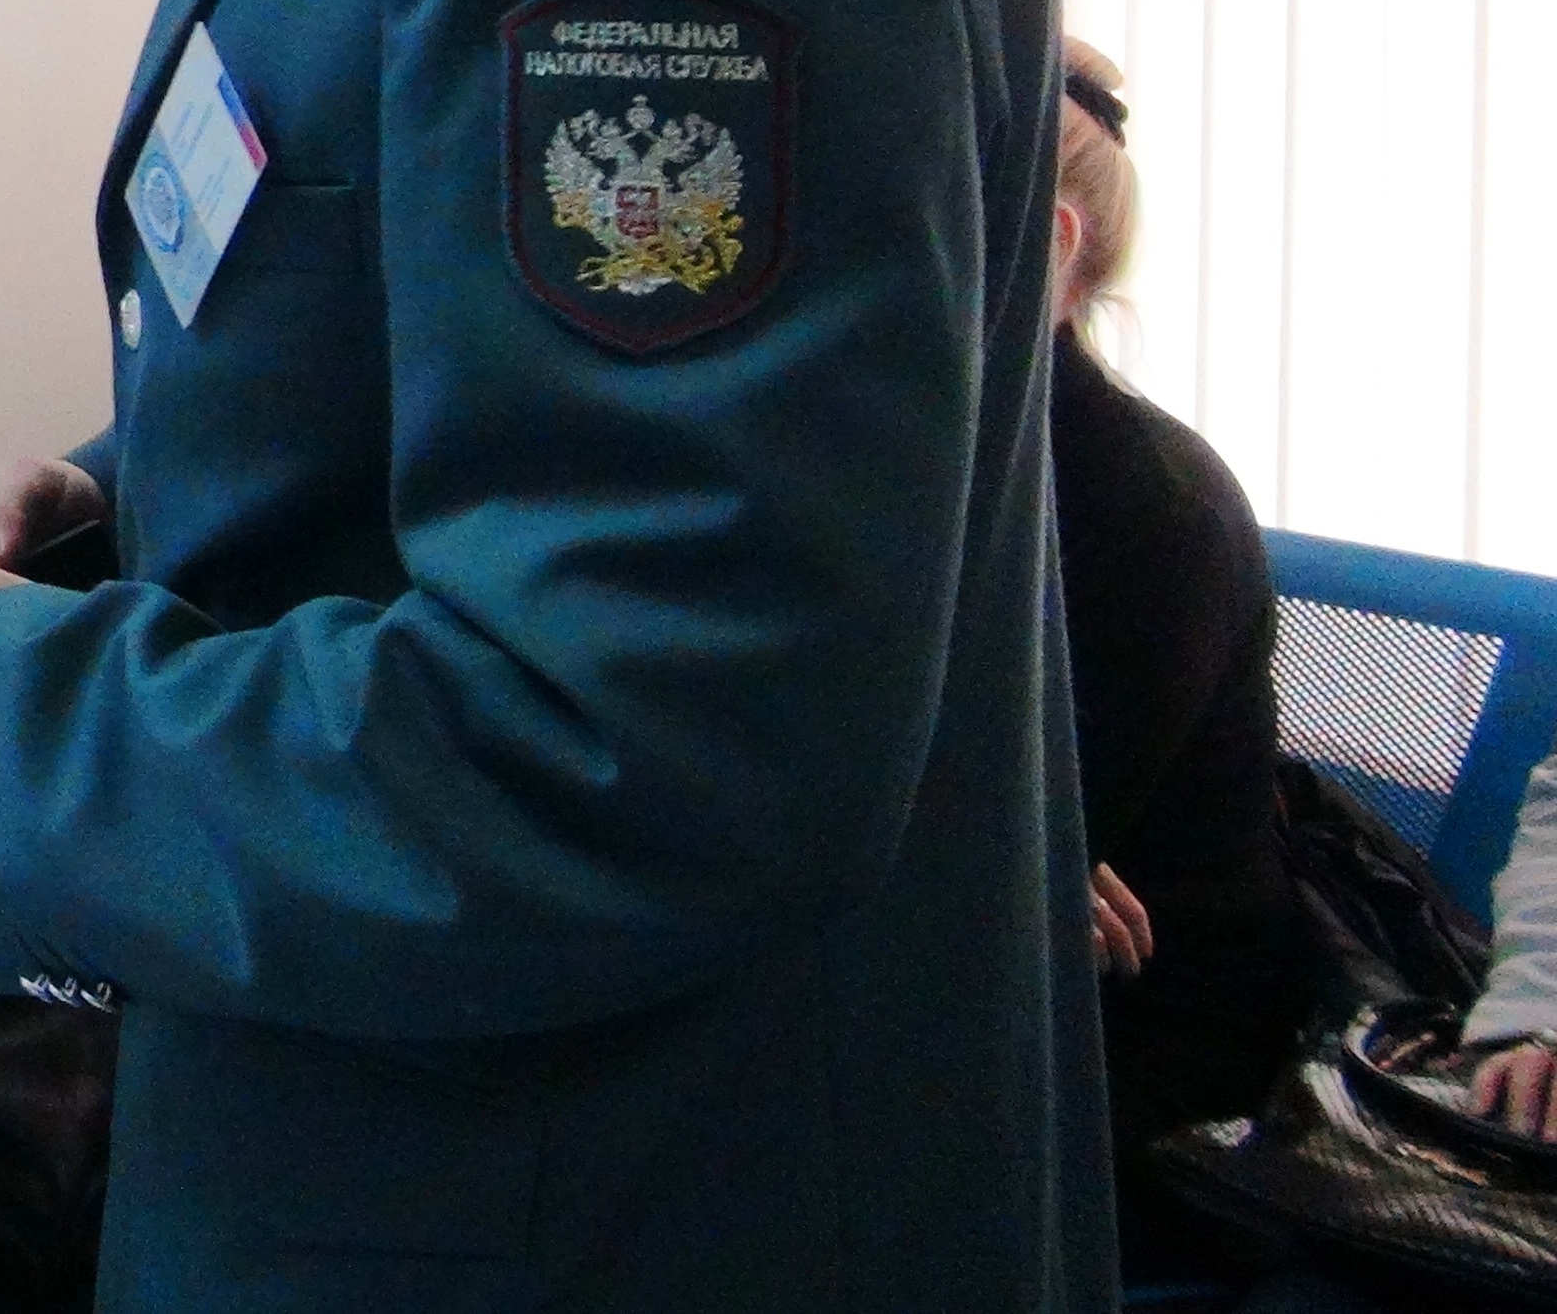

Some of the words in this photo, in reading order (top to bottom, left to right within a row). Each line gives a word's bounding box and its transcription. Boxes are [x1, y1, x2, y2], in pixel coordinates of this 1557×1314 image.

[550, 20, 740, 49] ФЕДЕРАЛЬНАЯ
[524, 50, 662, 80] НАЛОГОВАЯ
[664, 53, 769, 81] СЛУЖБА
